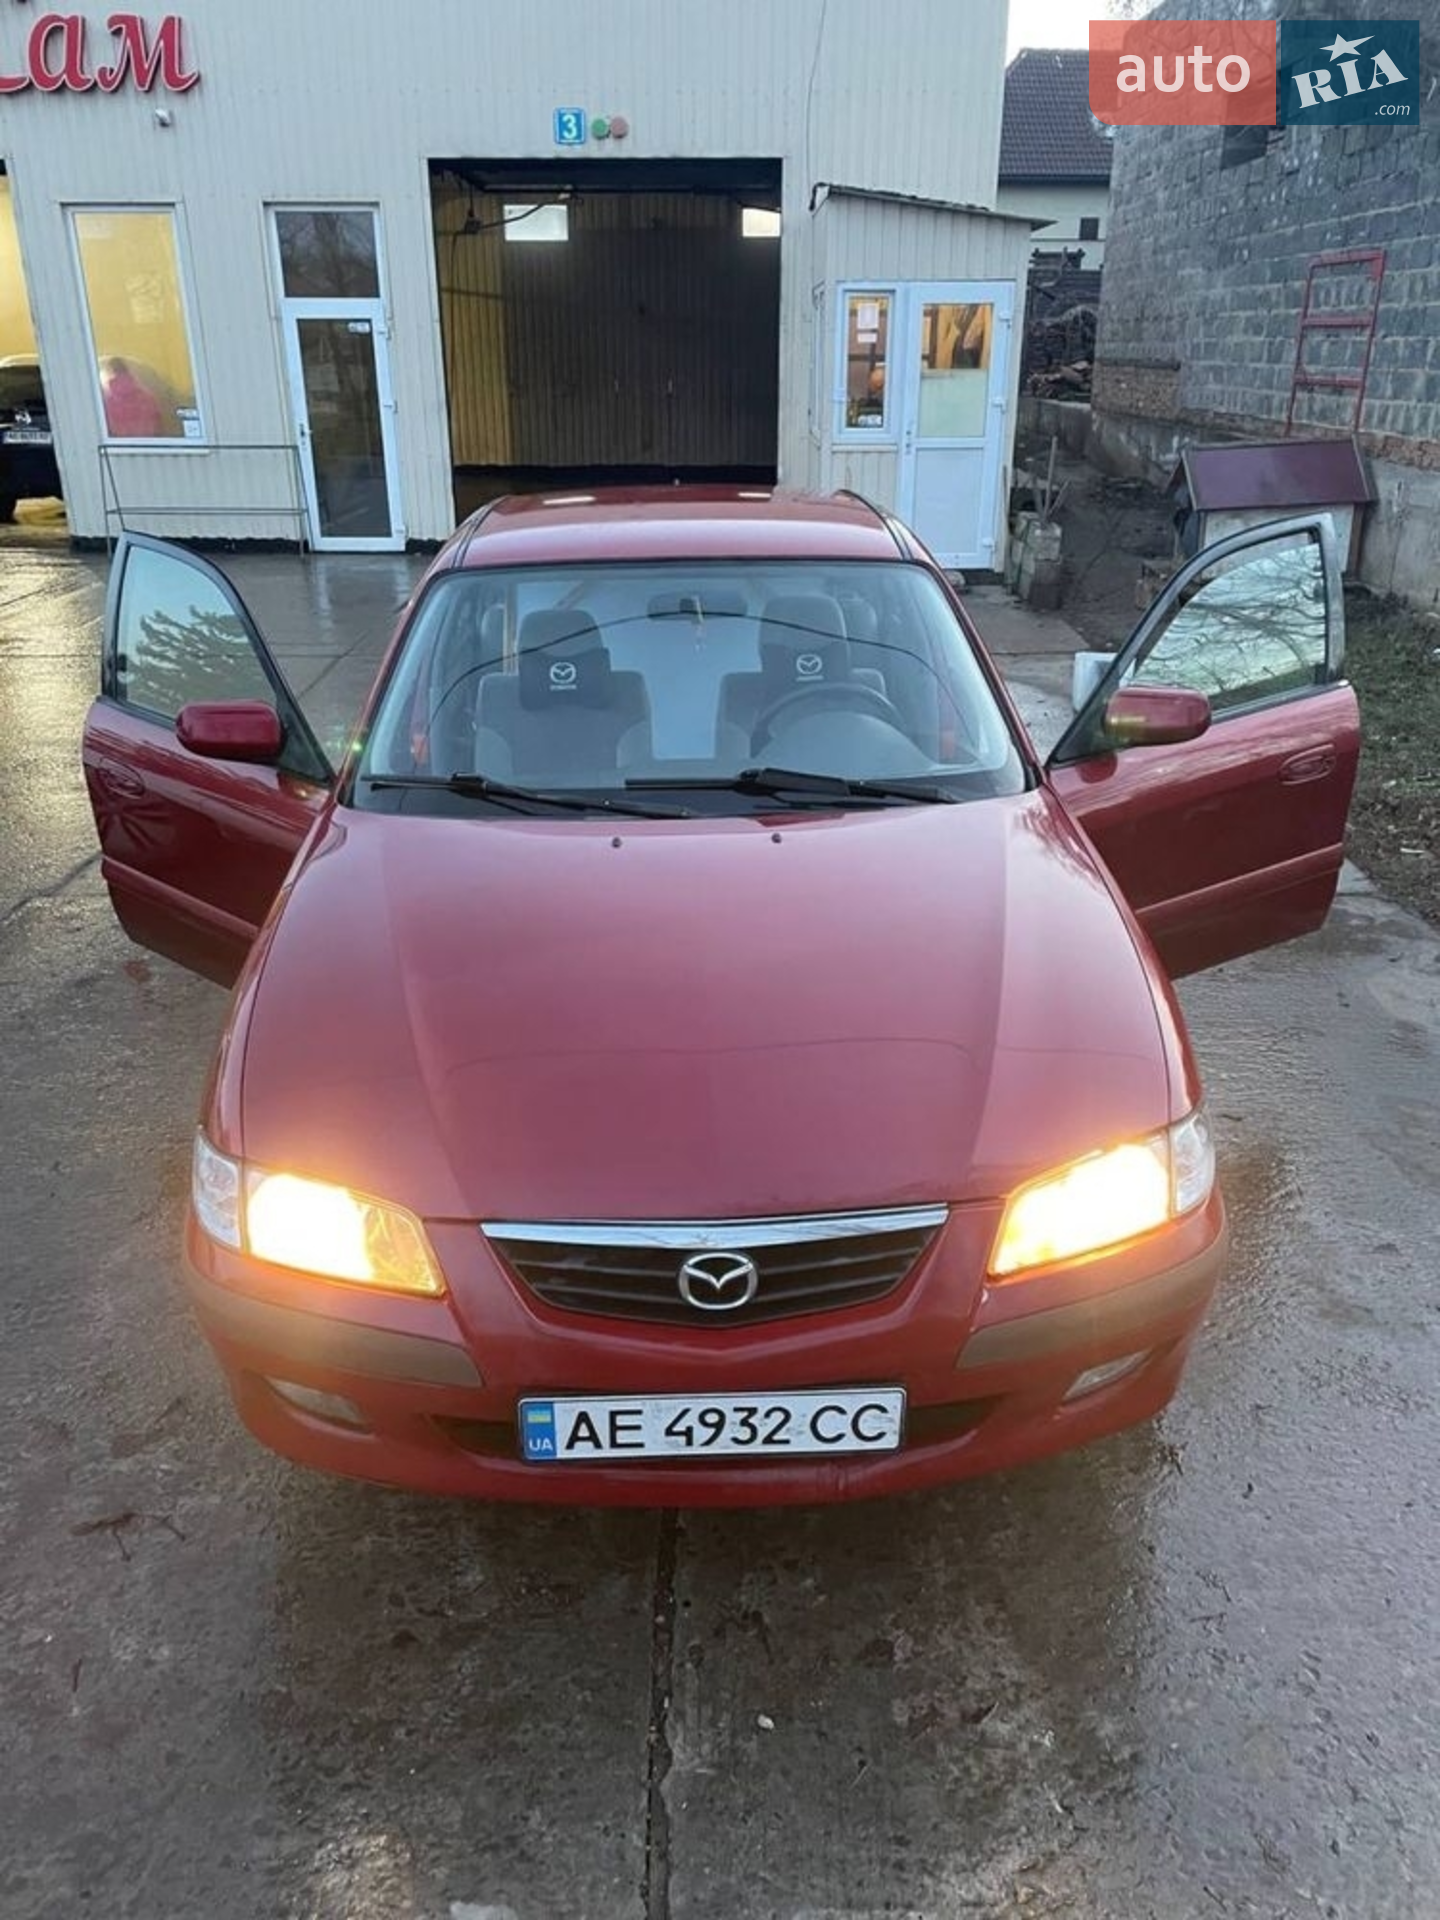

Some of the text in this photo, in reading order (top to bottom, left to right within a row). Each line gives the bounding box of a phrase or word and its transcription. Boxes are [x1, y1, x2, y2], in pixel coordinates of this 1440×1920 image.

[0, 12, 200, 93] ам
[562, 114, 577, 139] 3
[565, 1403, 889, 1450] AE 4932 CC
[529, 1438, 554, 1452] UA
